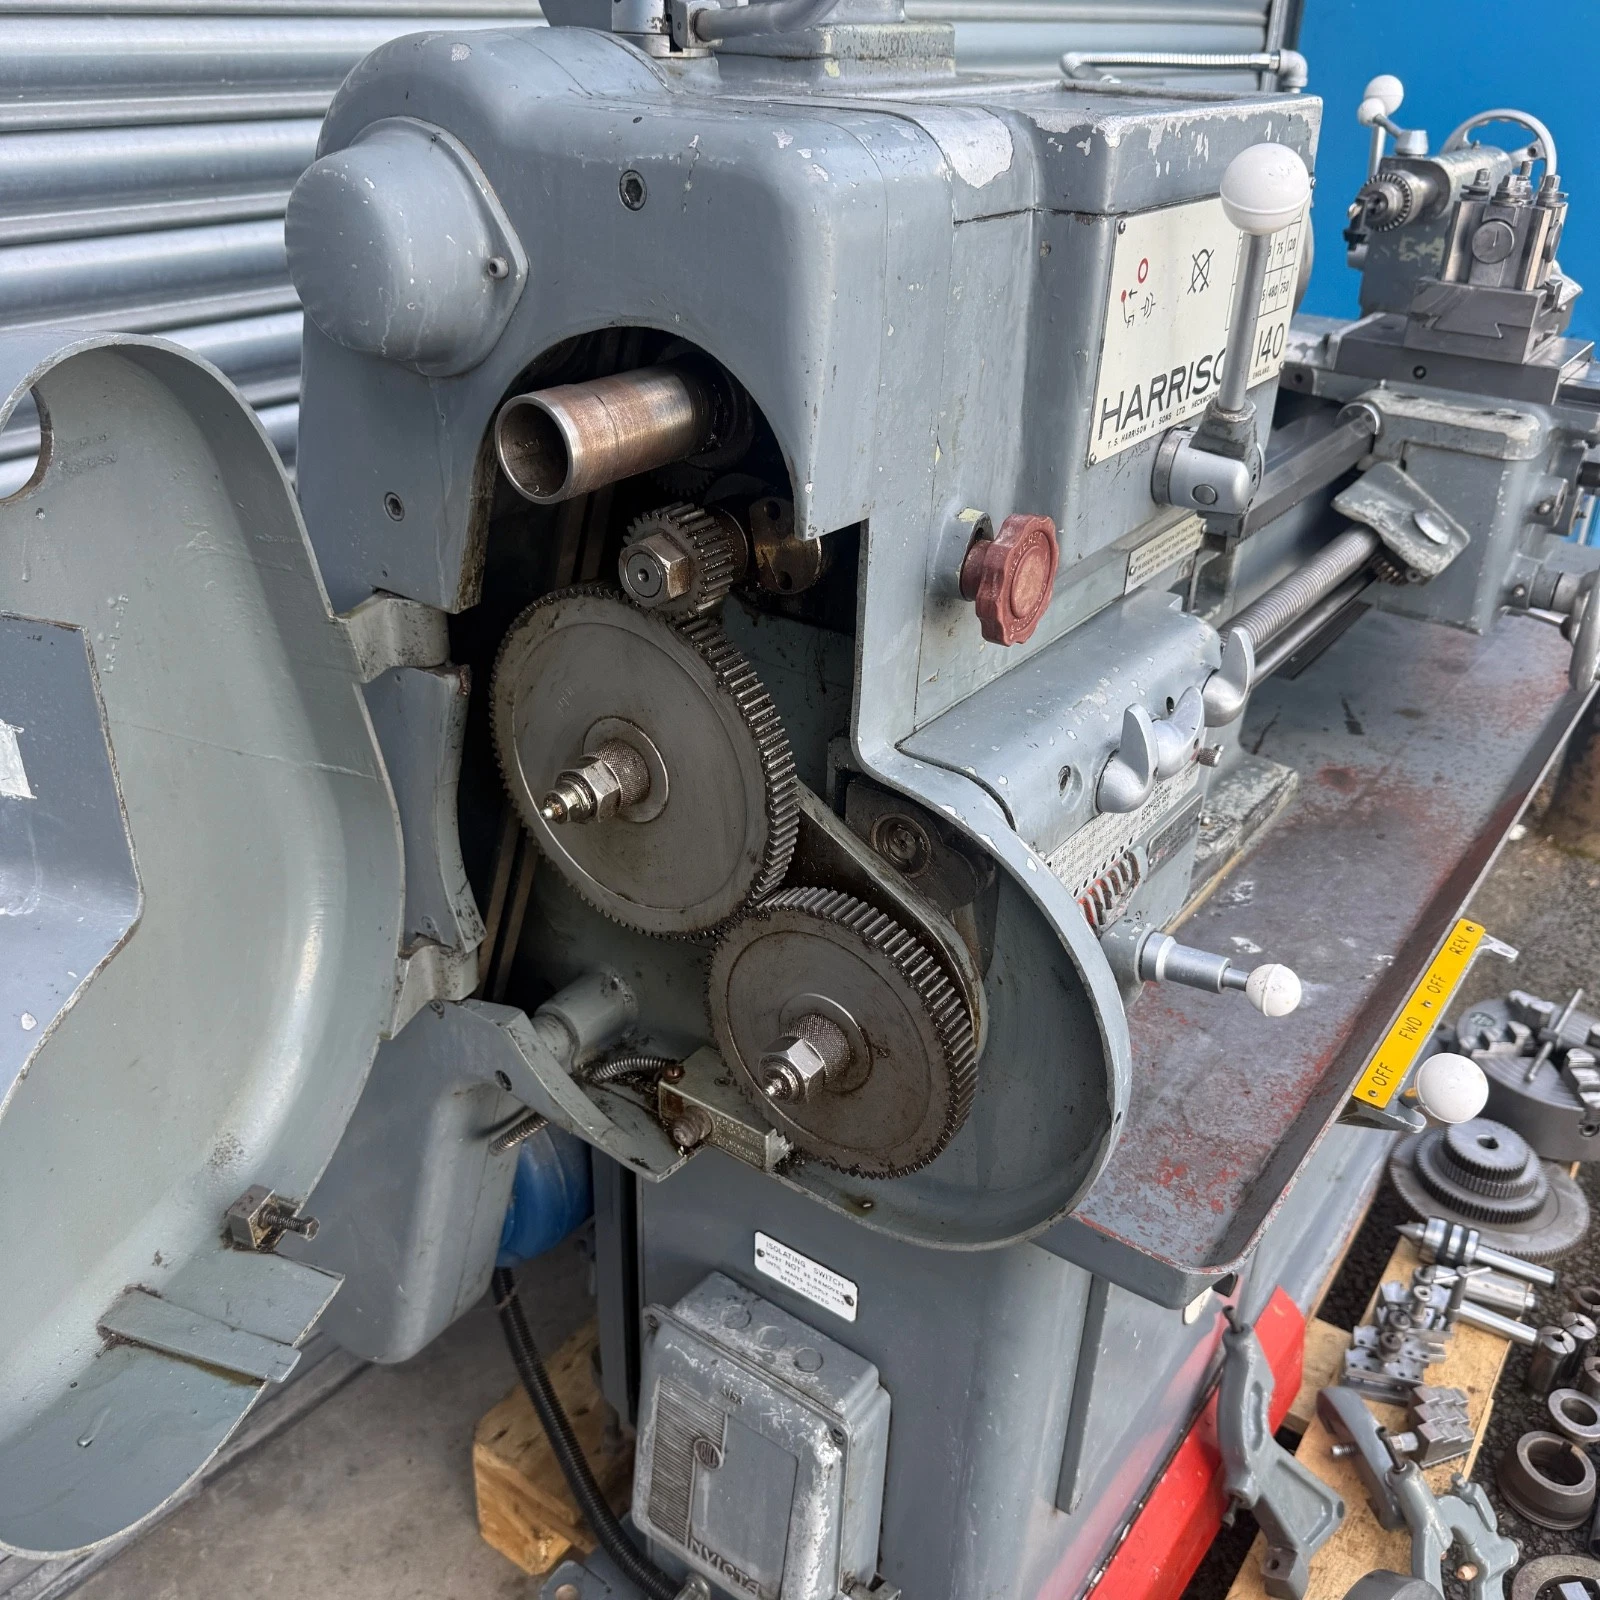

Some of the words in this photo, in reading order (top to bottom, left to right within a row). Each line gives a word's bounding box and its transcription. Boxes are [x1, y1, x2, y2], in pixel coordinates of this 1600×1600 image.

[1255, 322, 1284, 368] 140
[1121, 423, 1148, 443] HARRISON
[1159, 412, 1172, 425] SONS
[1371, 1062, 1394, 1087] OFF
[1398, 1016, 1423, 1041] FWD
[1426, 973, 1447, 994] OFF
[1449, 935, 1471, 956] REV
[766, 1241, 806, 1268] ISOLATING
[814, 1267, 844, 1289] SWITCH
[785, 1260, 800, 1273] NOT
[785, 1270, 803, 1282] MAINS
